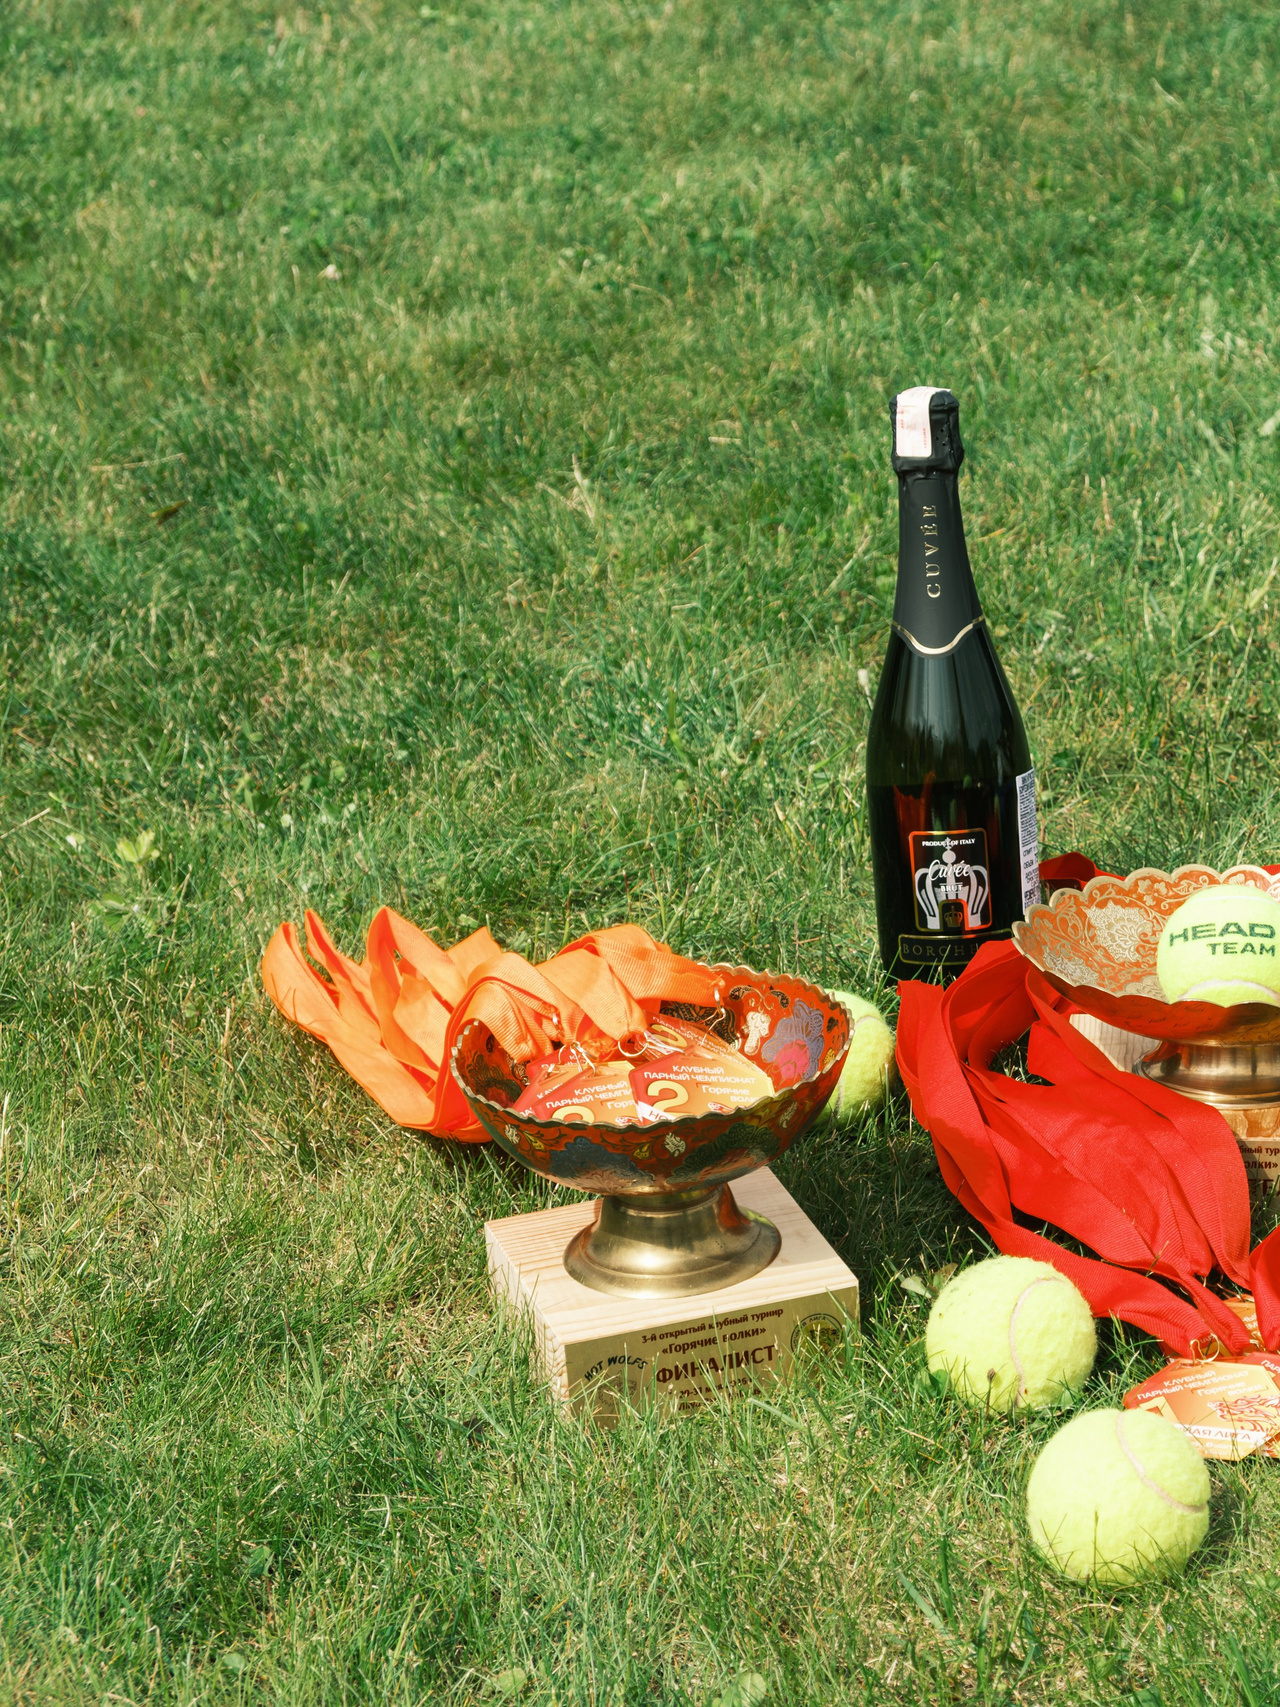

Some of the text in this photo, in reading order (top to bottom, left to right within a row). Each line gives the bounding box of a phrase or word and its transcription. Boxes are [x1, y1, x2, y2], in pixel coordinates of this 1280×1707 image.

[920, 504, 941, 599] CUVÉE
[929, 860, 971, 880] Cuvée
[1169, 922, 1276, 947] HEAD
[1206, 942, 1276, 957] TEAM
[673, 1065, 724, 1075] КЛУБНЫЙ
[644, 1072, 757, 1085] ПАРНЫЙ ЧЕМПИОНАТ
[574, 1080, 628, 1096] КЛУБНЫЙ
[702, 1085, 750, 1096] Горячие
[546, 1088, 633, 1109] ПАРНЫЙ ЧЕМПИ
[607, 1099, 637, 1110] Горя
[647, 1080, 694, 1116] 2
[730, 1095, 760, 1103] волк
[1245, 1159, 1279, 1170] олки»
[642, 1333, 657, 1344] 3-й
[659, 1322, 706, 1339] открытый
[751, 1308, 784, 1321] турнир
[662, 1327, 767, 1355] «Горячие волки»
[584, 1355, 648, 1382] HOT WOLFS
[656, 1345, 776, 1383] ФИНАЛИСТ
[1137, 1370, 1250, 1400] ПАРНЫЙ ЧЕМПИОНАТ
[1163, 1370, 1217, 1387] КЛУБНЫЙ
[1197, 1381, 1246, 1397] Горячие
[1228, 1384, 1263, 1396] волки
[1214, 1430, 1251, 1440] ЛИГА
